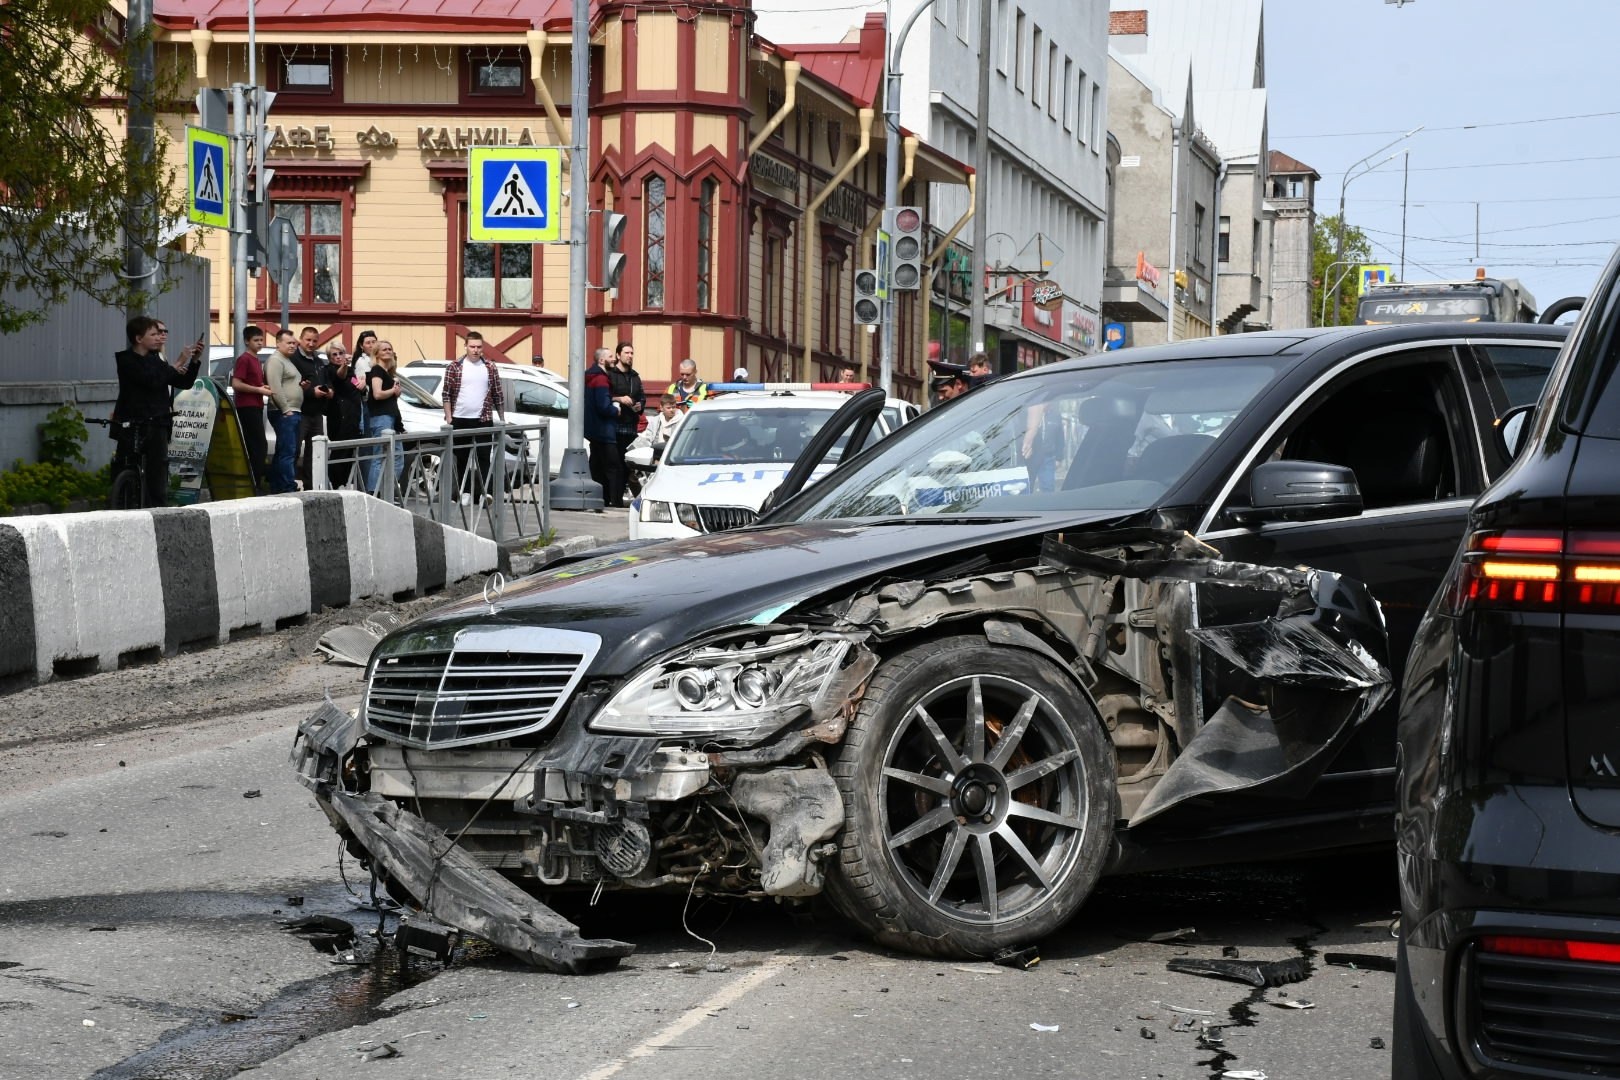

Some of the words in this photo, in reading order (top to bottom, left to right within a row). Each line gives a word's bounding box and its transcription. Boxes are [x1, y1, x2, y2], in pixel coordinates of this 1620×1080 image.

[265, 125, 333, 149] АФЕ
[417, 126, 536, 150] KAHVILA
[172, 420, 208, 429] АДОЖСКИЕ
[175, 431, 198, 439] ШХЕРЫ
[943, 483, 1002, 503] ПОЛИЦИЯ
